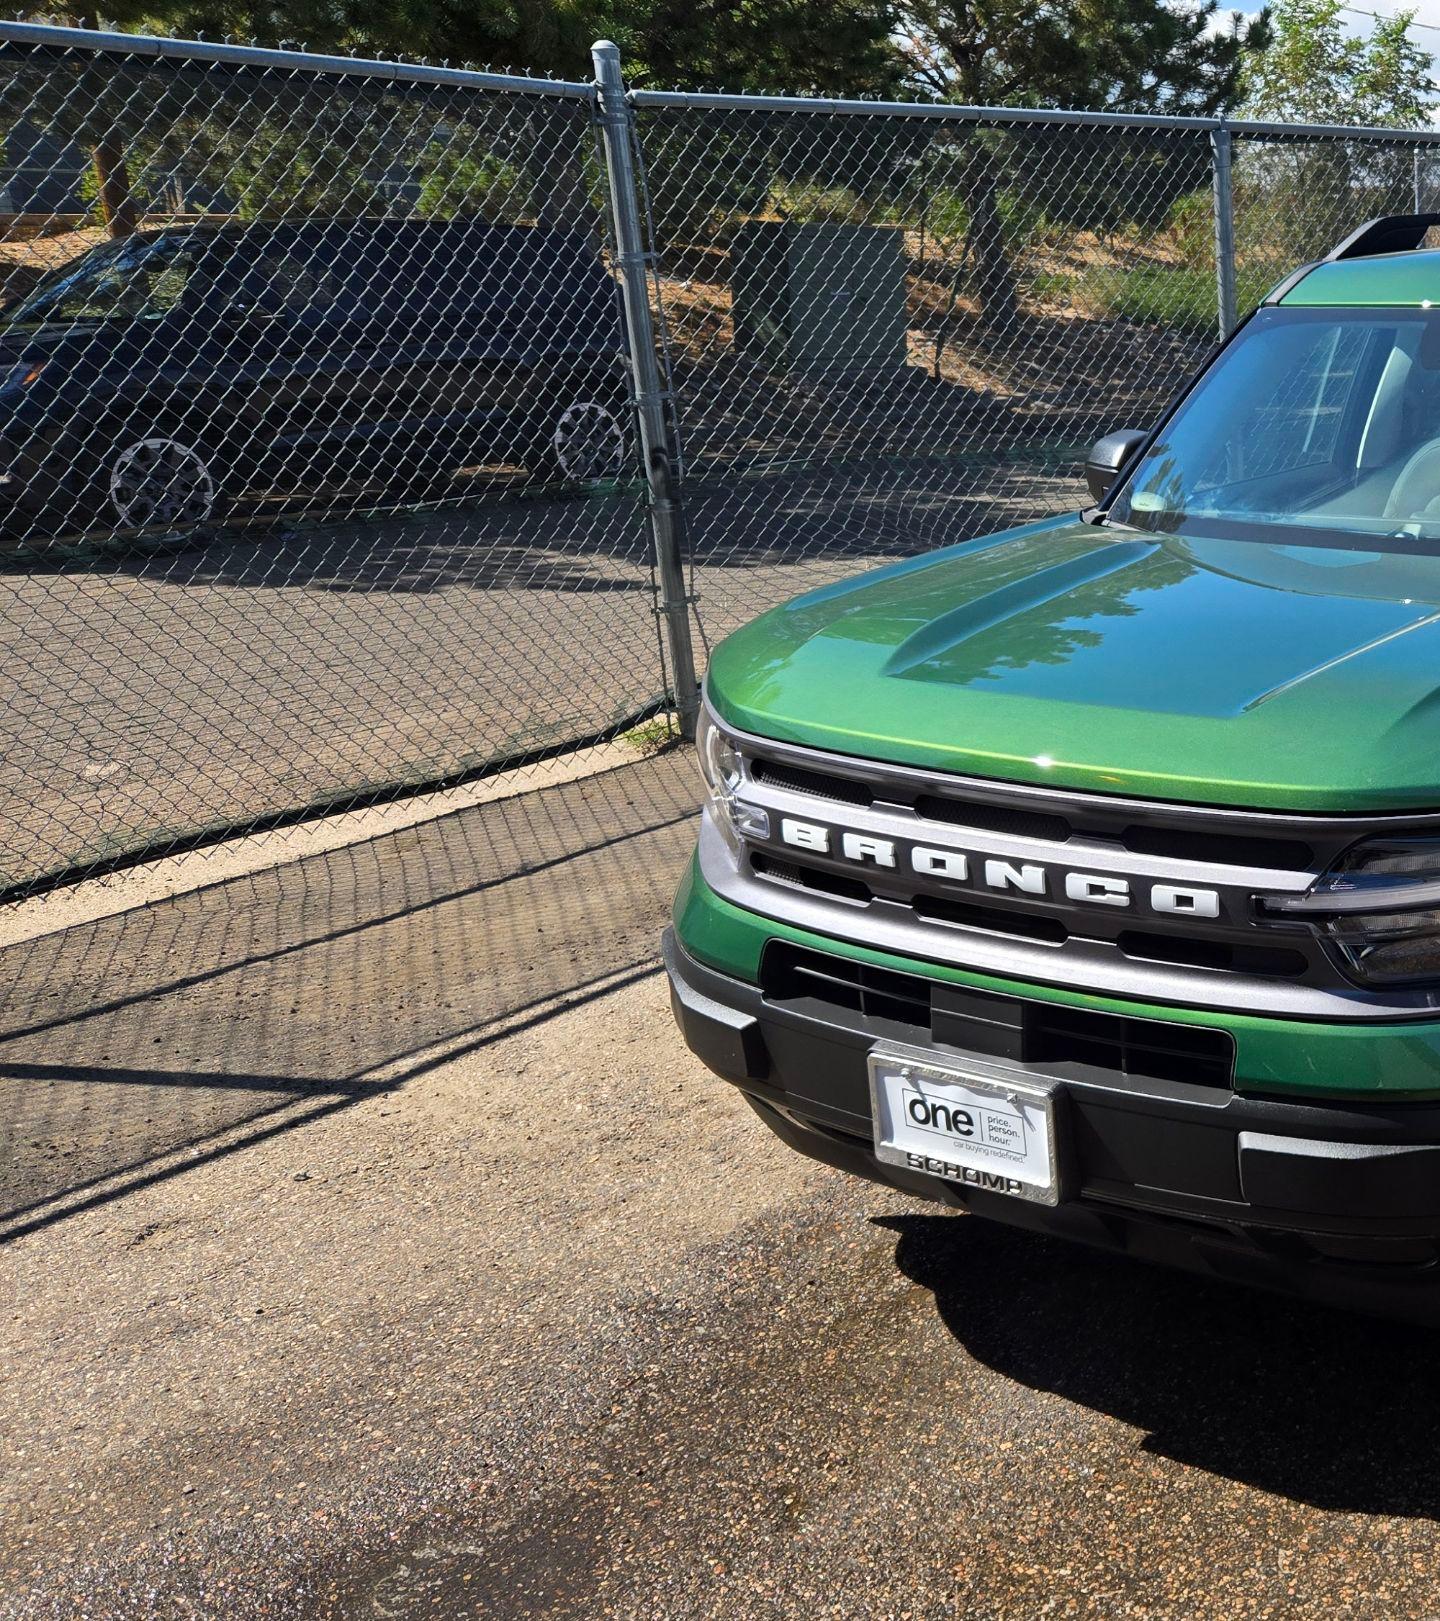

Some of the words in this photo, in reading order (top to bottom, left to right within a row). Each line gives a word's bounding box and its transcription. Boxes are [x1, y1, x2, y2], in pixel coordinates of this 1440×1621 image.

[781, 818, 1219, 918] BRONCO
[908, 1098, 974, 1137] one
[987, 1116, 1012, 1128] price.
[988, 1124, 1021, 1138] person.
[966, 1143, 989, 1156] buying
[906, 1152, 1023, 1195] SCHOMP
